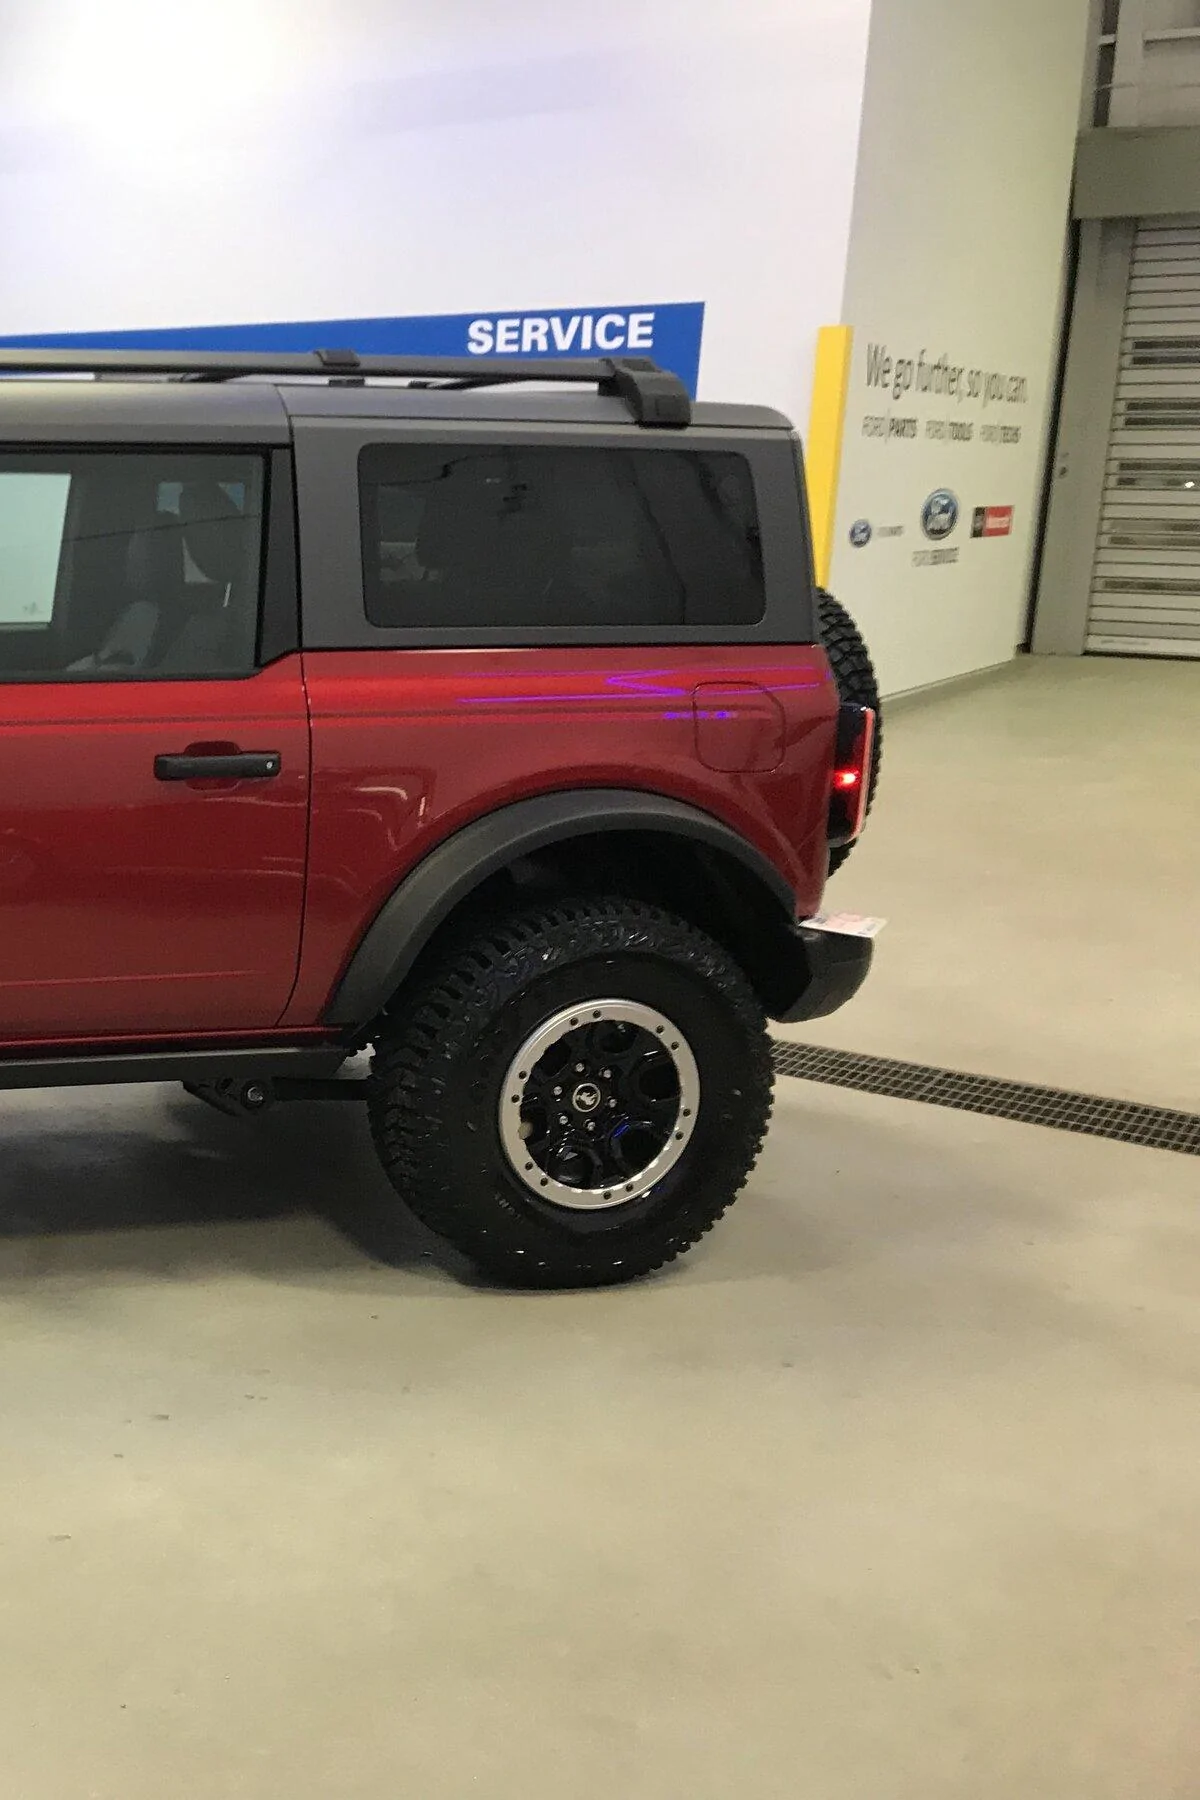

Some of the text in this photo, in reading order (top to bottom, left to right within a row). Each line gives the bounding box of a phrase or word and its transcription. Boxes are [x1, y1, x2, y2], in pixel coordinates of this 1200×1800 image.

[467, 312, 656, 355] SERVICE
[866, 342, 892, 389] We
[893, 358, 915, 401] go
[967, 369, 983, 398] so
[983, 372, 1007, 409] you
